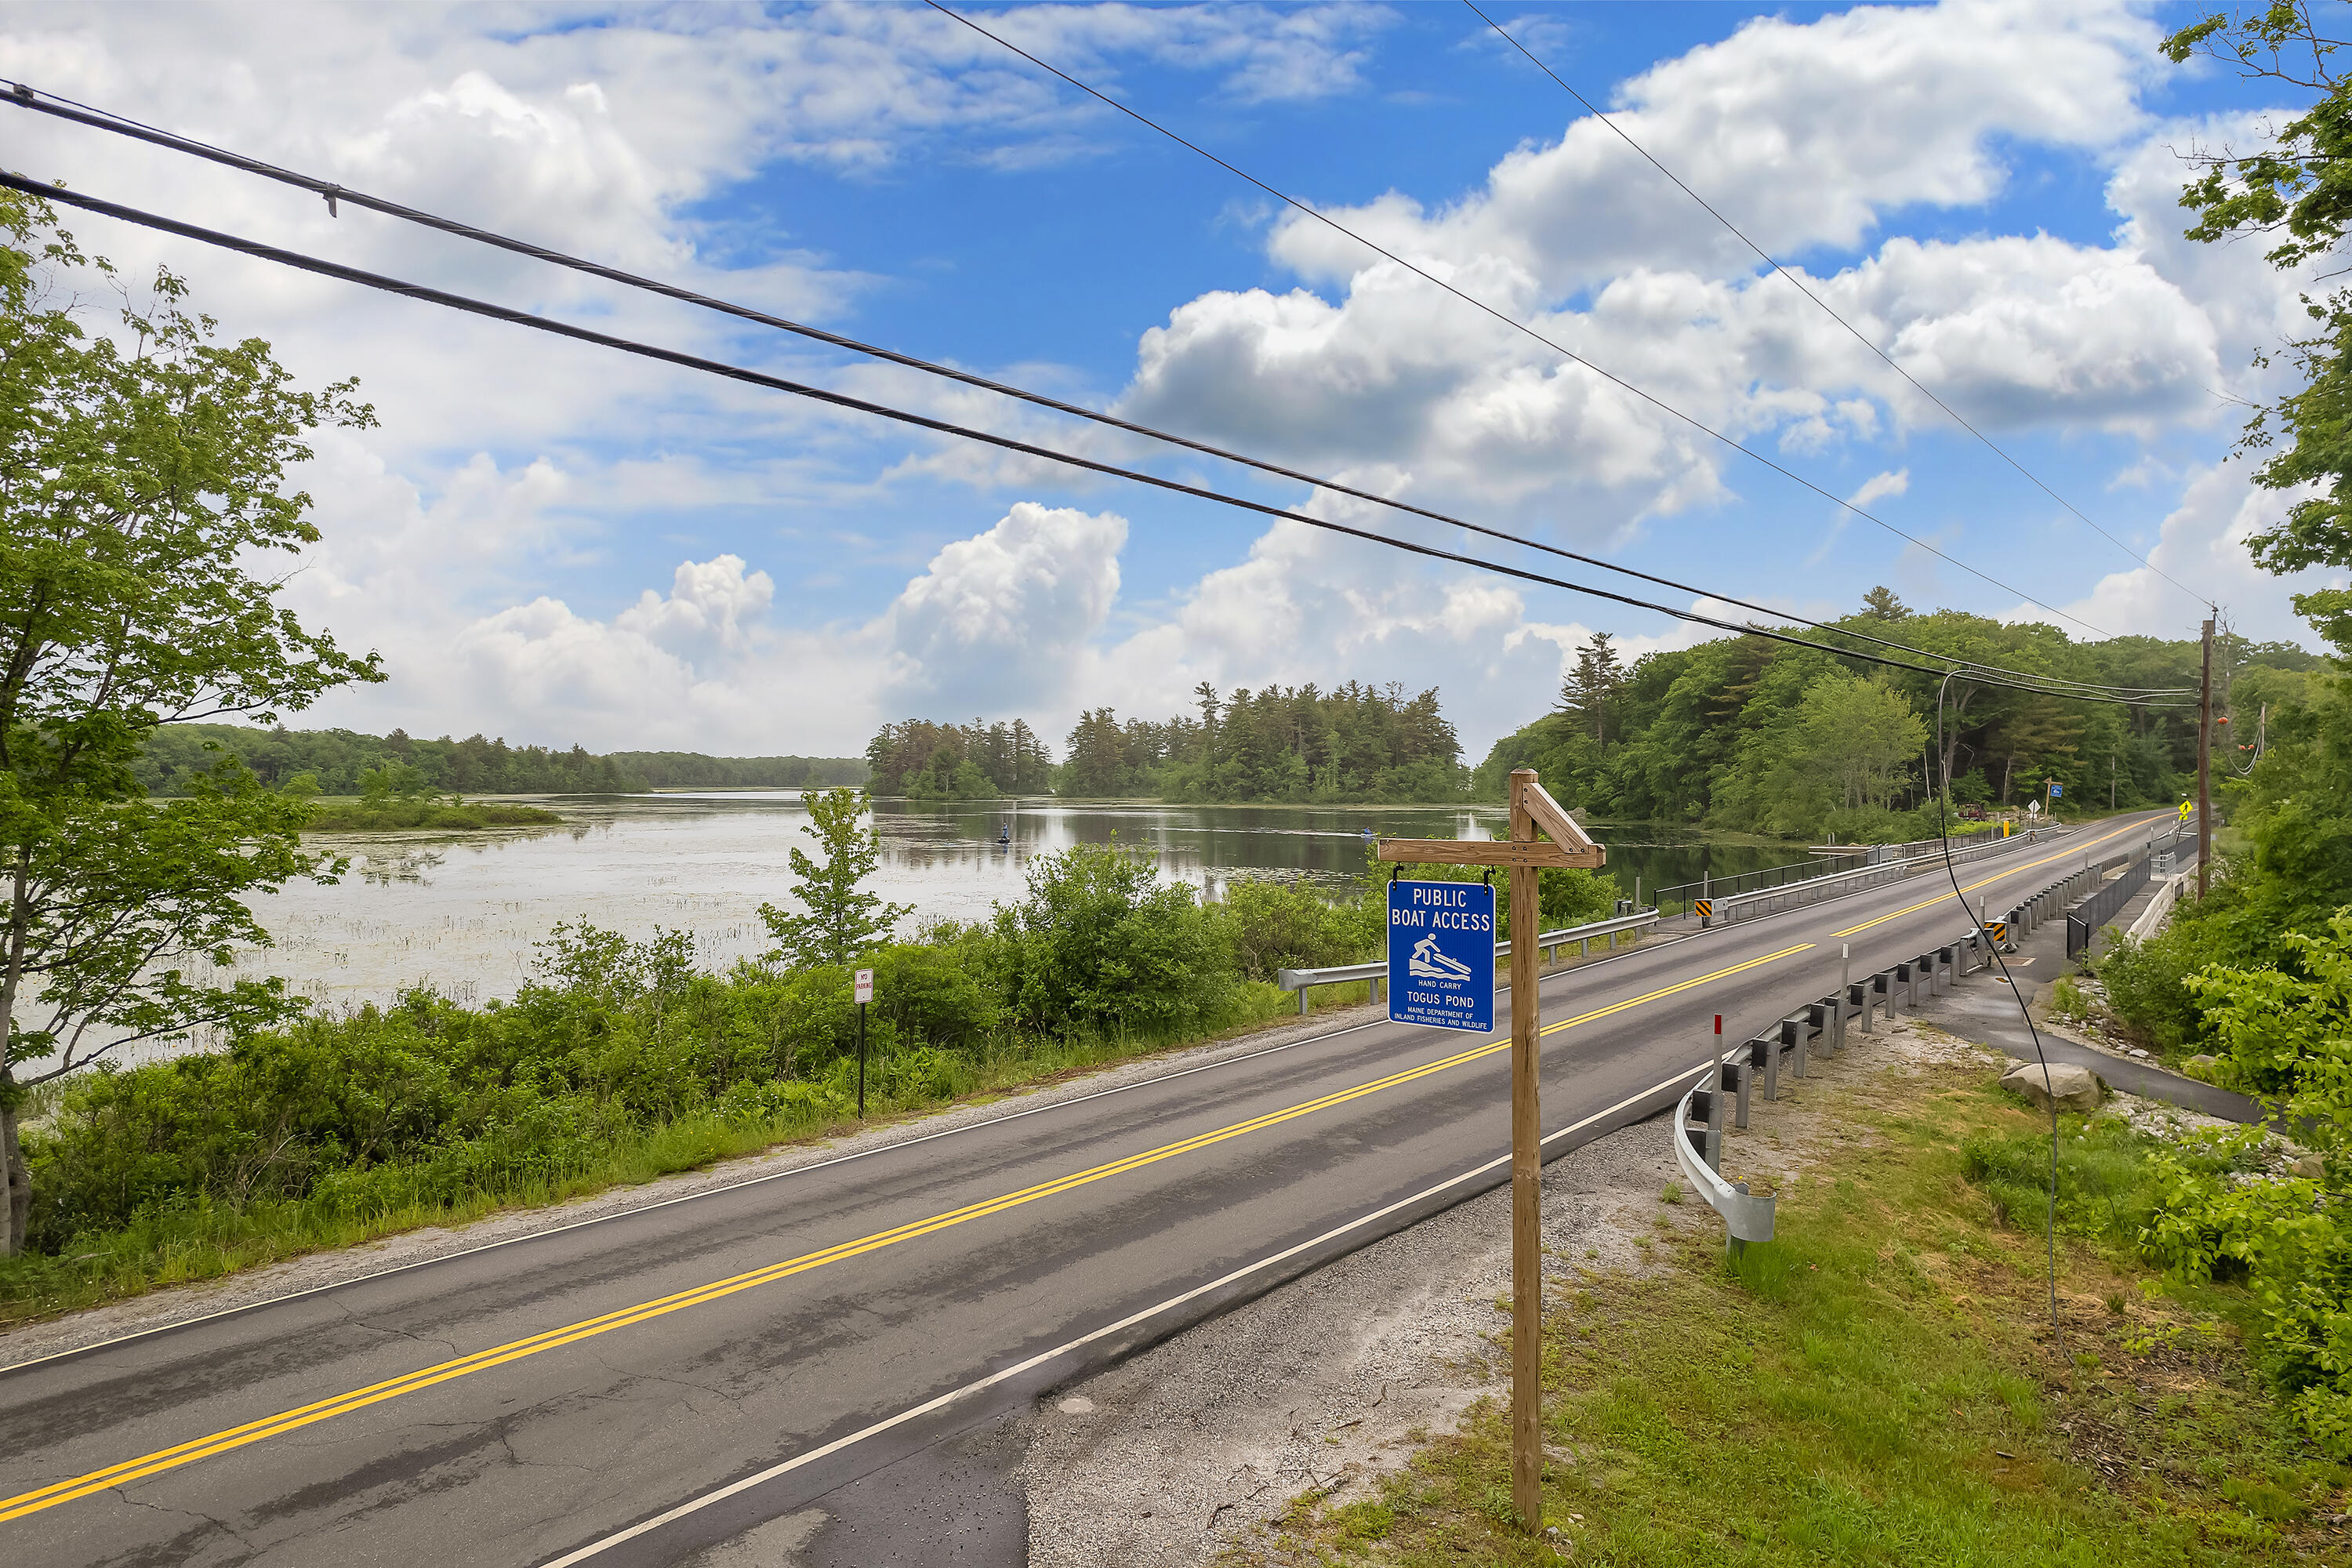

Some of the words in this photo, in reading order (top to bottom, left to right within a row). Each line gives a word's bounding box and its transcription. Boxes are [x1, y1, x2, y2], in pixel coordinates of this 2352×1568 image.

[1414, 888, 1466, 907] PUBLIC
[1392, 909, 1426, 927] BOAT
[1432, 912, 1490, 931] ACCESS
[1407, 991, 1440, 1004] TOGUS
[1446, 996, 1474, 1007] POND
[1428, 1009, 1464, 1018] DEPARTMENT
[1462, 1021, 1486, 1029] WILDLIFE
